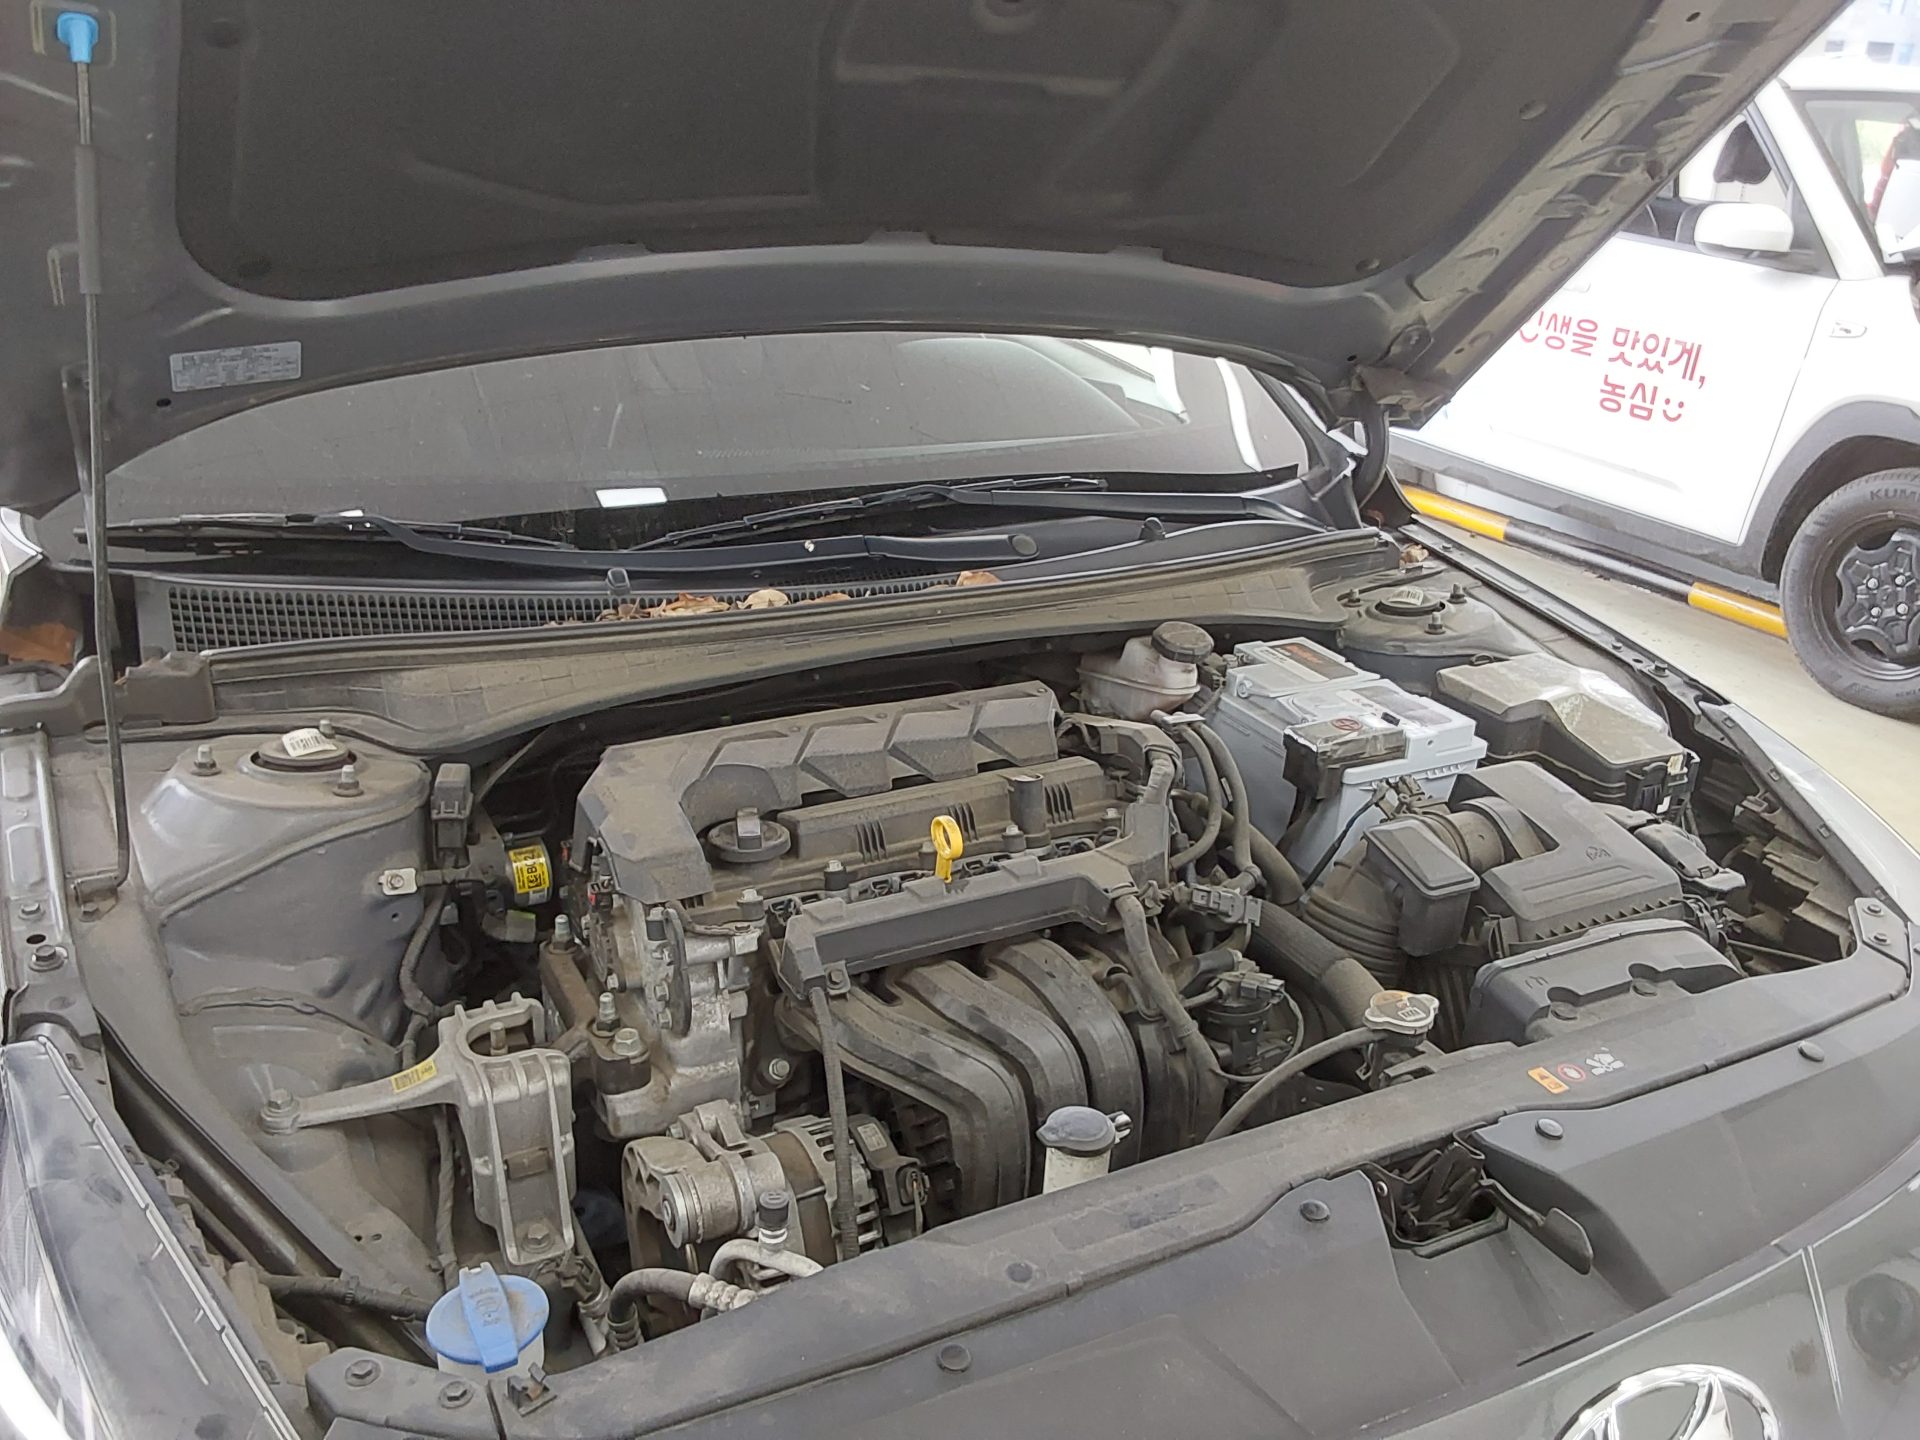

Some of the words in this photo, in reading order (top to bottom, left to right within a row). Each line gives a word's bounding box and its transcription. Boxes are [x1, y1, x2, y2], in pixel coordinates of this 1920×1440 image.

[1607, 327, 1706, 389] 맛있게,
[1599, 374, 1658, 422] 농심
[1869, 488, 1920, 502] KUM
